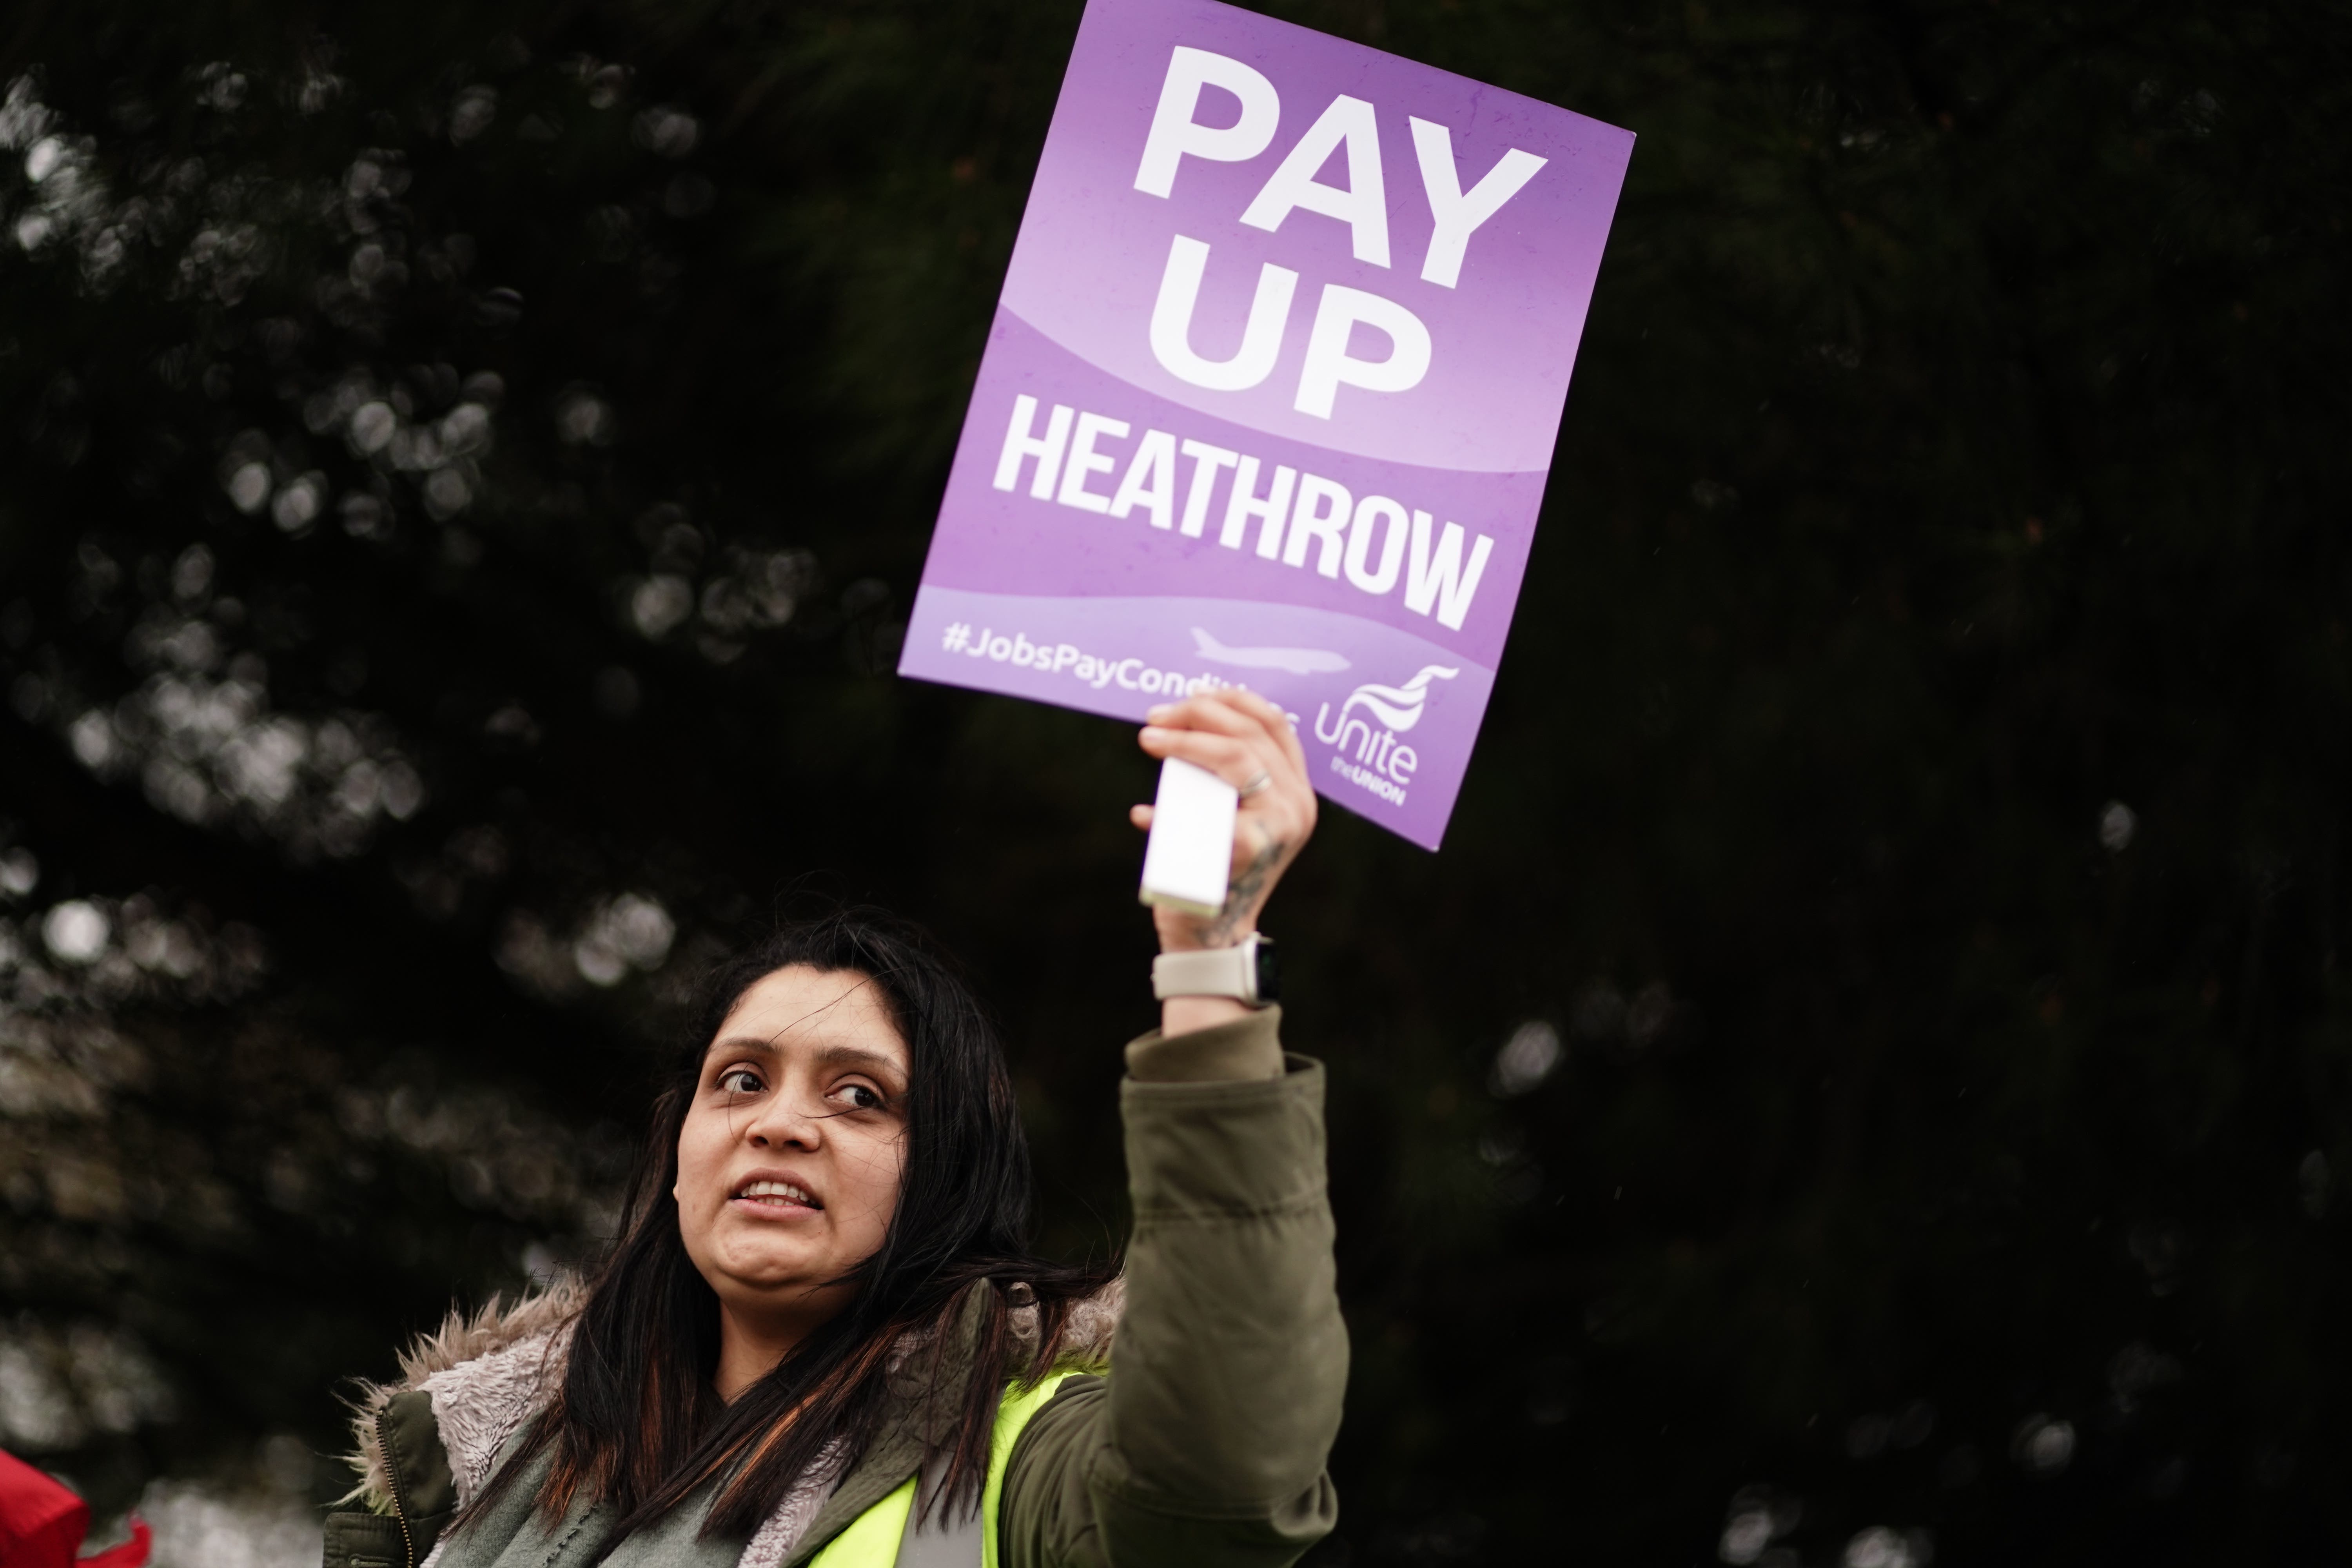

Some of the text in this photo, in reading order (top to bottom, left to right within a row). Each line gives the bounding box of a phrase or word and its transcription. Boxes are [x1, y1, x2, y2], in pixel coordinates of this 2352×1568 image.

[1134, 46, 1548, 289] PAY
[1149, 234, 1432, 420] UP
[993, 394, 1494, 631] HEATHROW
[942, 622, 1301, 734] #JobsPayConds
[1314, 702, 1417, 784] unite
